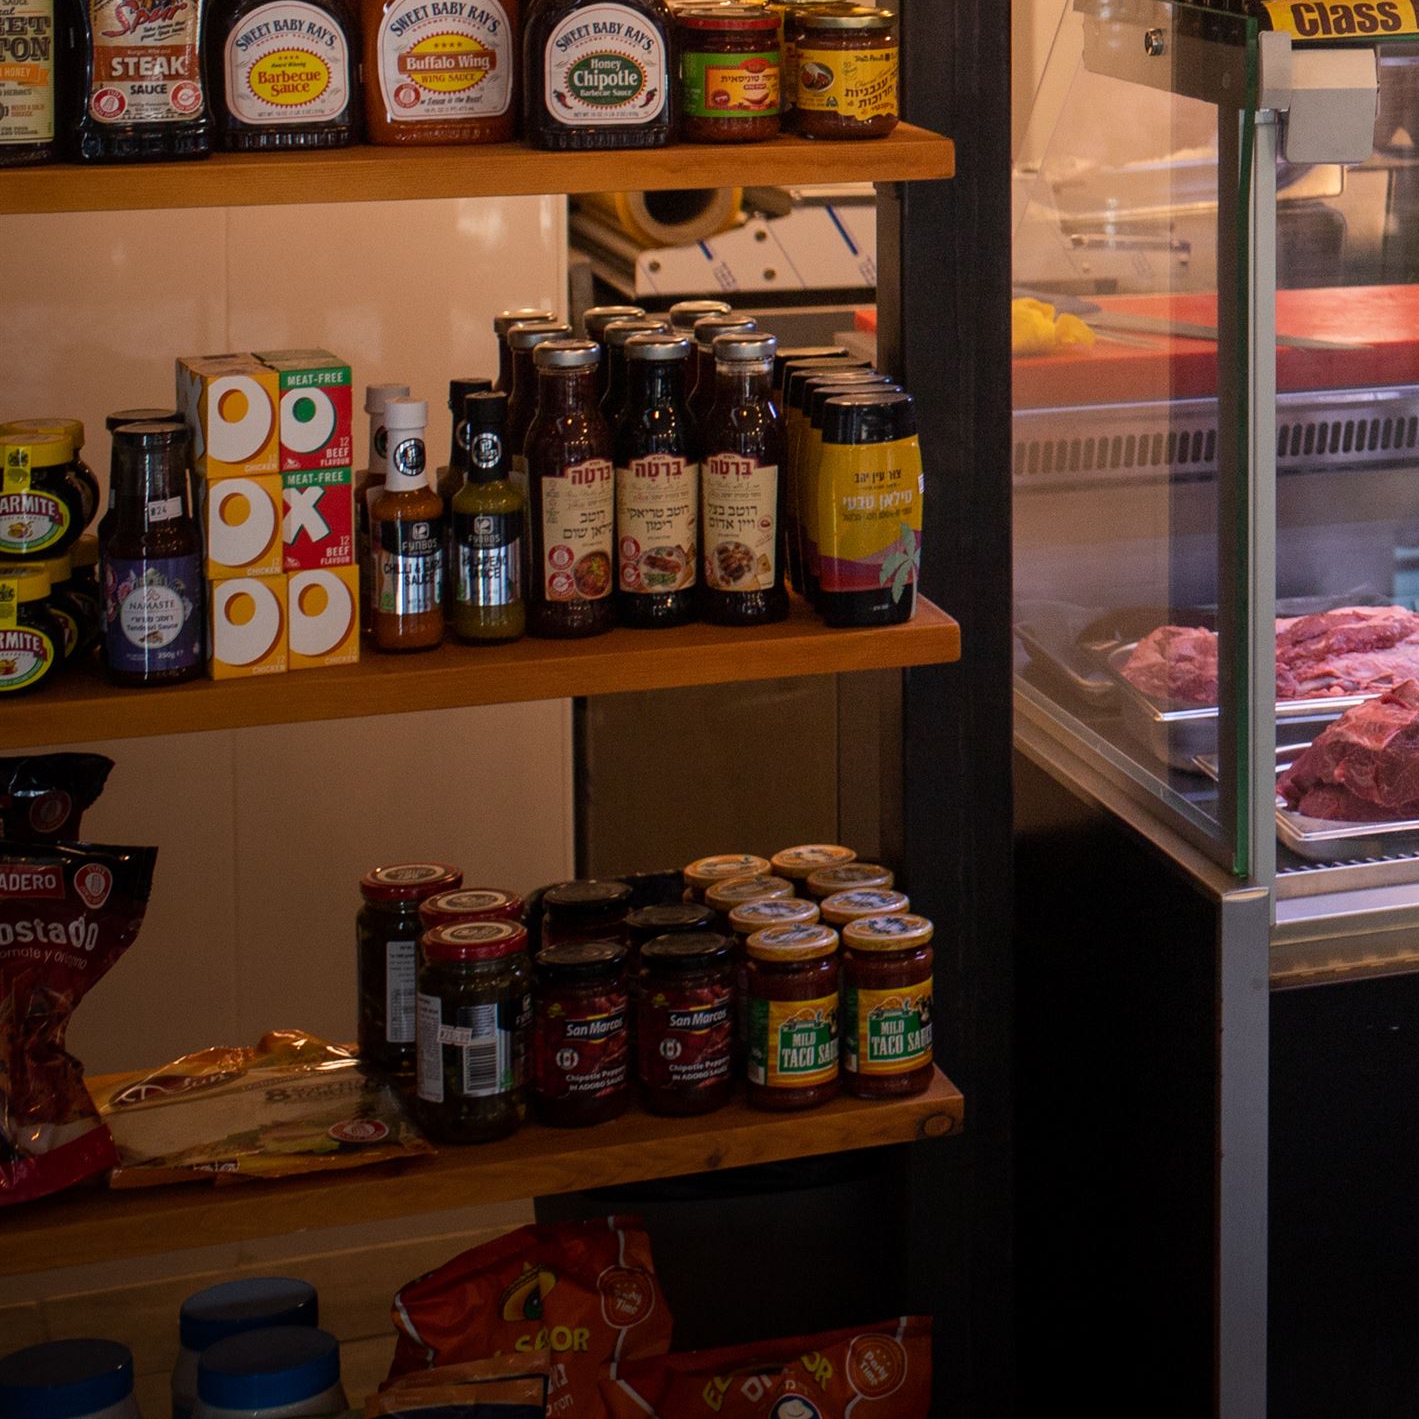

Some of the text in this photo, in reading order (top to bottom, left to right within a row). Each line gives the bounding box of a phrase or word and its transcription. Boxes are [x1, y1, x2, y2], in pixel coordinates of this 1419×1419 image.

[389, 0, 502, 37] SWEET BABY RAY'S
[1289, 0, 1402, 38] Class
[235, 22, 272, 53] SWEET
[274, 18, 306, 34] BABY
[306, 22, 338, 49] RAY'S
[555, 21, 654, 53] SWEET BABY RAY'S
[111, 55, 186, 78] STEAK
[405, 54, 491, 73] Buffalo Wing
[589, 57, 622, 72] Honey
[257, 70, 321, 85] Barbecue
[421, 72, 479, 83] WING SAUCE
[573, 69, 639, 89] Chipotle
[129, 83, 168, 96] SAUCE
[270, 80, 310, 98] Sauce
[286, 371, 345, 386] MEAT-FREE
[339, 436, 351, 448] 12
[325, 446, 350, 459] BEEF
[320, 457, 351, 467] FLAVOUR
[286, 470, 345, 486] MEAT-FREE
[0, 494, 57, 516] ARMITE
[842, 488, 913, 513] סילאן טבעי
[580, 509, 606, 524] רוטב
[666, 504, 690, 518] רוטב
[727, 505, 758, 517] רוטב
[563, 527, 588, 540] שום
[645, 520, 673, 533] רימון
[339, 535, 351, 547] 12
[325, 544, 350, 558] BEEF
[320, 555, 351, 566] FLAVOUR
[129, 600, 176, 611] NAMASTE
[0, 873, 57, 892] ADERO
[0, 915, 99, 952] ostado
[43, 949, 53, 966] y
[668, 1009, 728, 1028] San Marcos
[565, 1017, 624, 1037] San Marcos
[880, 1019, 905, 1035] MILD
[791, 1031, 817, 1047] MILD
[871, 1034, 904, 1056] TACO
[781, 1046, 815, 1069] TACO
[668, 1061, 704, 1073] Chipotle
[565, 1071, 601, 1083] Chipotle
